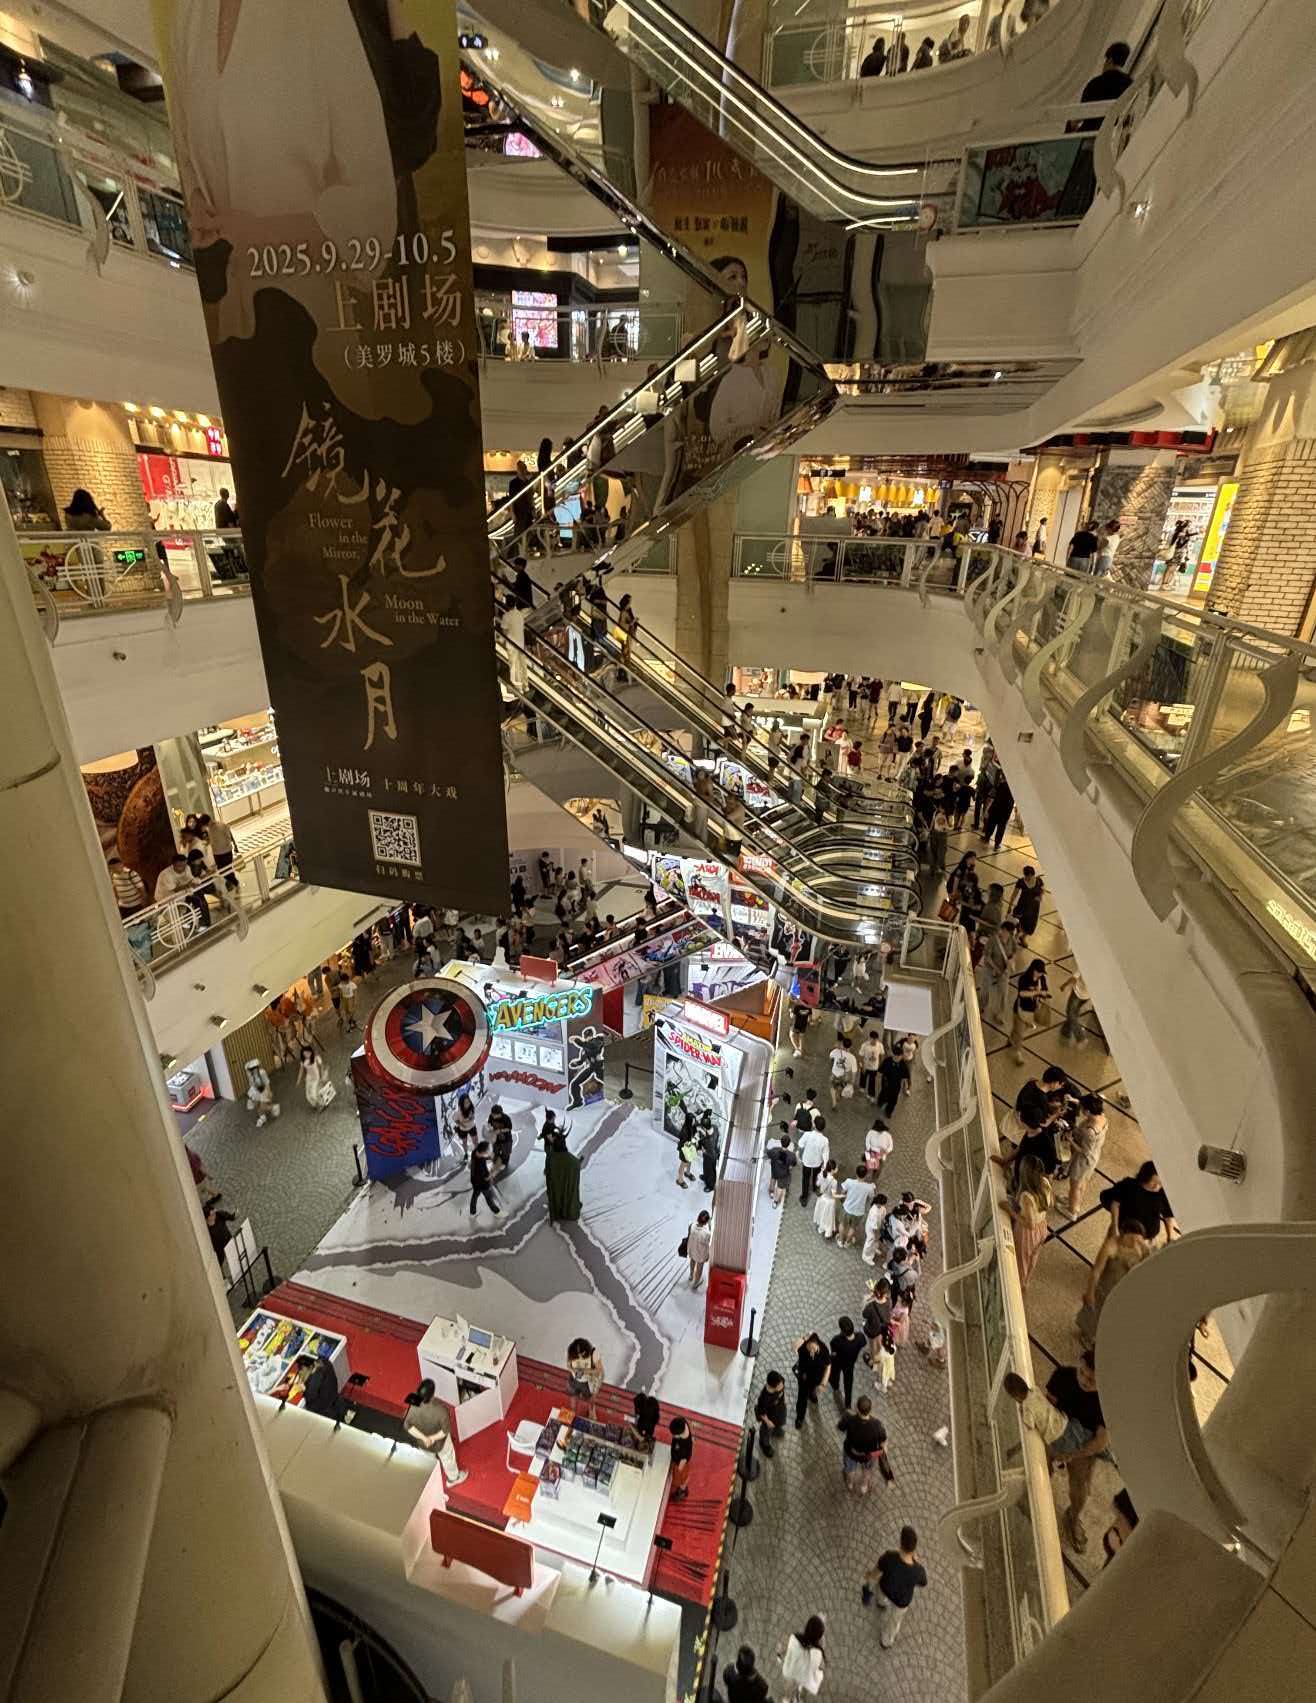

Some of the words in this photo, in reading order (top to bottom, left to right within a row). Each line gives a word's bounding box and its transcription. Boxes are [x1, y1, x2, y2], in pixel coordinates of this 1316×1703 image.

[247, 229, 457, 277] 2025.9.29-10.5
[326, 272, 464, 332] 上剧场
[308, 512, 354, 529] Flower
[340, 532, 351, 544] in
[352, 530, 369, 546] the
[385, 593, 425, 610] Moon
[393, 611, 407, 624] in
[407, 611, 426, 625] the
[426, 612, 461, 627] Water
[496, 985, 593, 1030] AVENGERS
